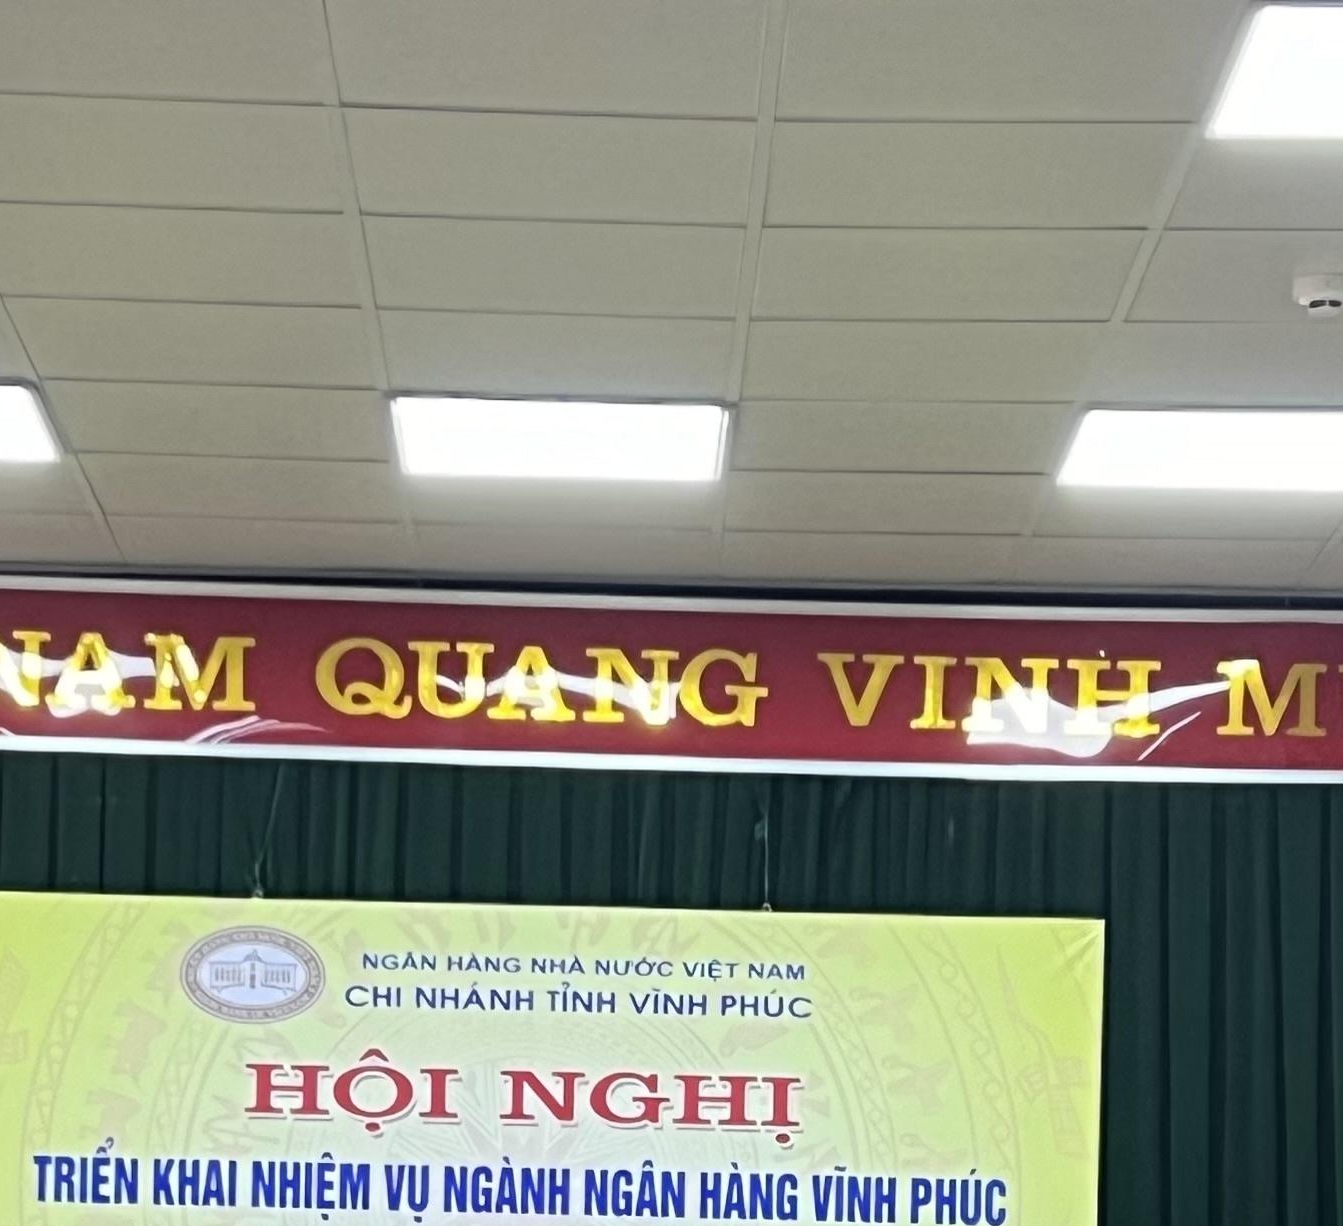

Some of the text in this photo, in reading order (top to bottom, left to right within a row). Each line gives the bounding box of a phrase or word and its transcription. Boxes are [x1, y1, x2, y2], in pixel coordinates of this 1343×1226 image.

[316, 637, 769, 727] QUANG
[818, 652, 1161, 738] VINH
[344, 985, 401, 1010] CHI
[415, 981, 534, 1013] NHÁNH
[546, 981, 616, 1014] TỈNH
[721, 986, 813, 1020] PHÚC
[361, 952, 805, 982] NGÂN HÀNG NHÀ NƯỚC VIỆT NAM
[245, 1048, 800, 1145] HỘI NGHỊ
[33, 1137, 1006, 1226] TRIỂN KHAI NHIỆM VỤ NGÀNH NGÂN HÀNG VĨNH PHÚC
